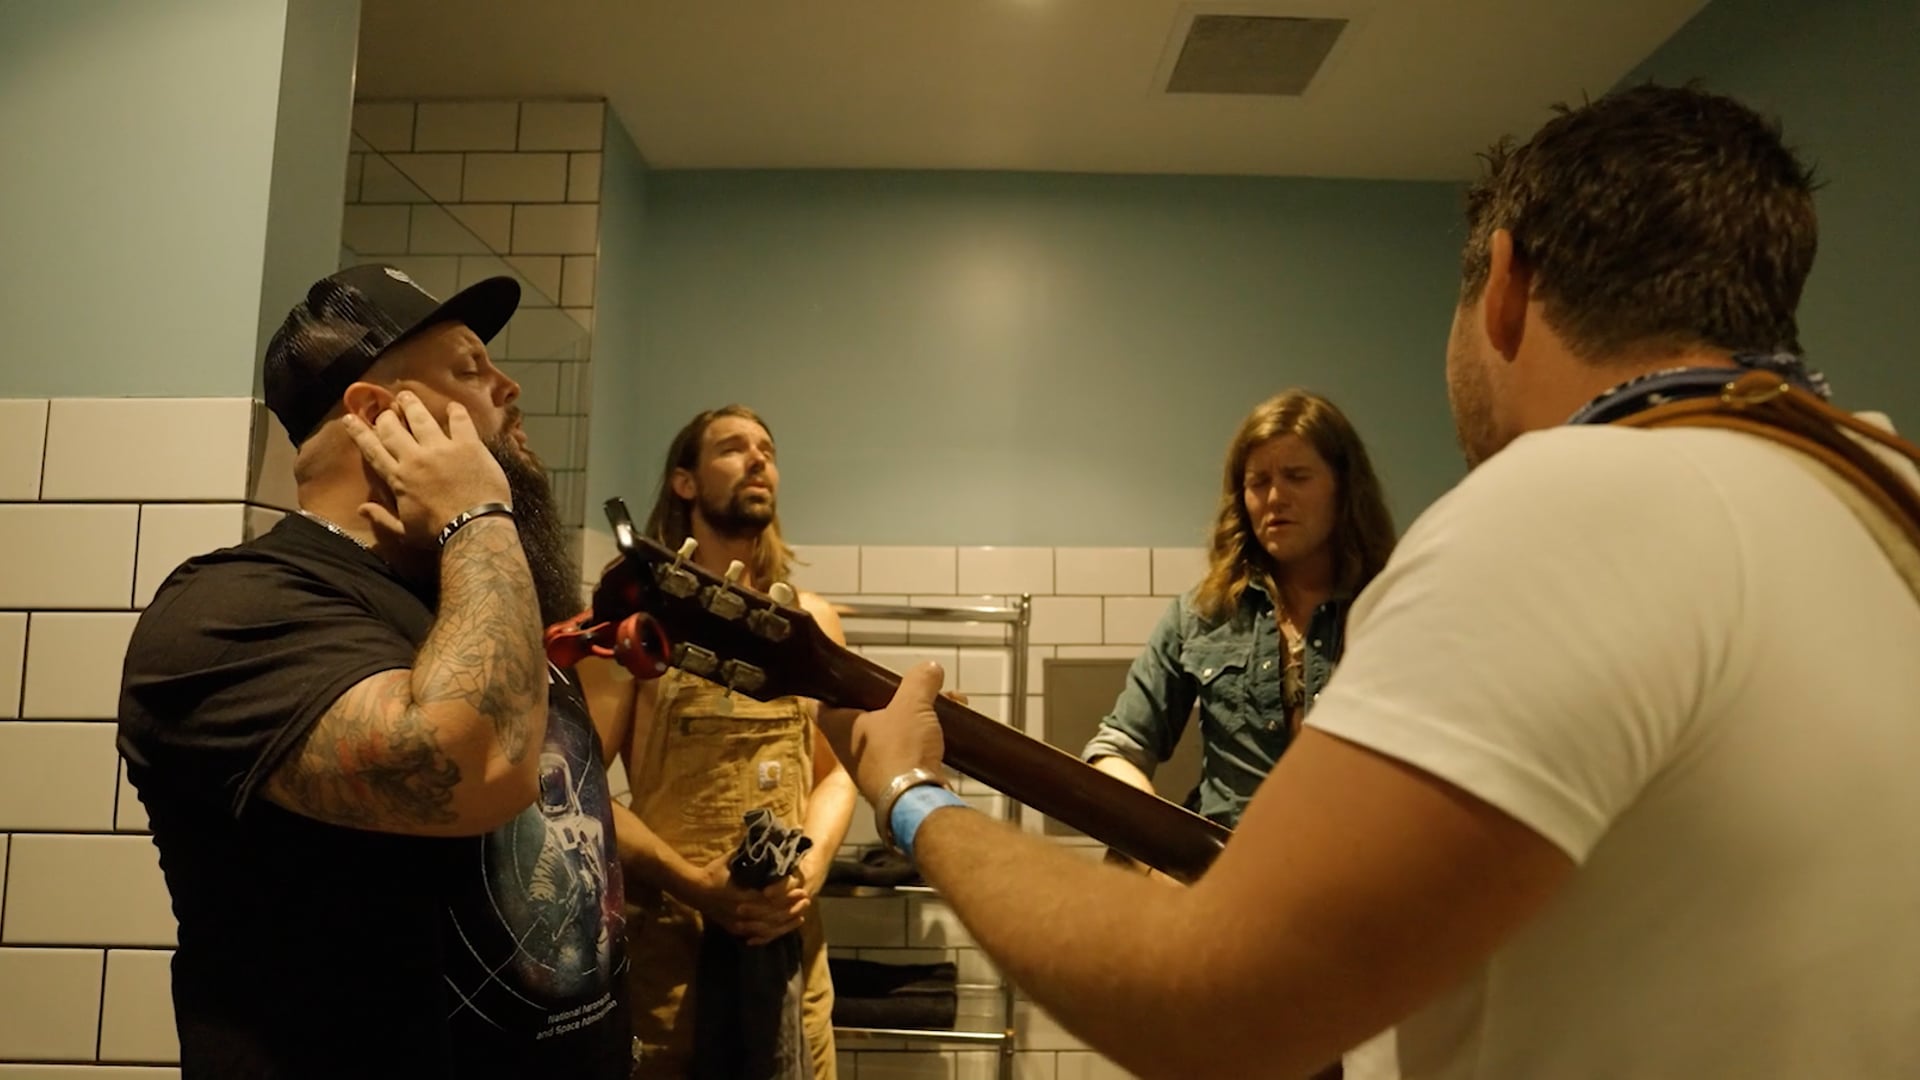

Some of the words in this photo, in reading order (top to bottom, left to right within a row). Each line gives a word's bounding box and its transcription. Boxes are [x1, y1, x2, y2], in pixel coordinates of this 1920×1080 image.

[548, 1006, 581, 1024] National
[536, 1026, 554, 1040] and
[555, 1021, 580, 1036] Space
